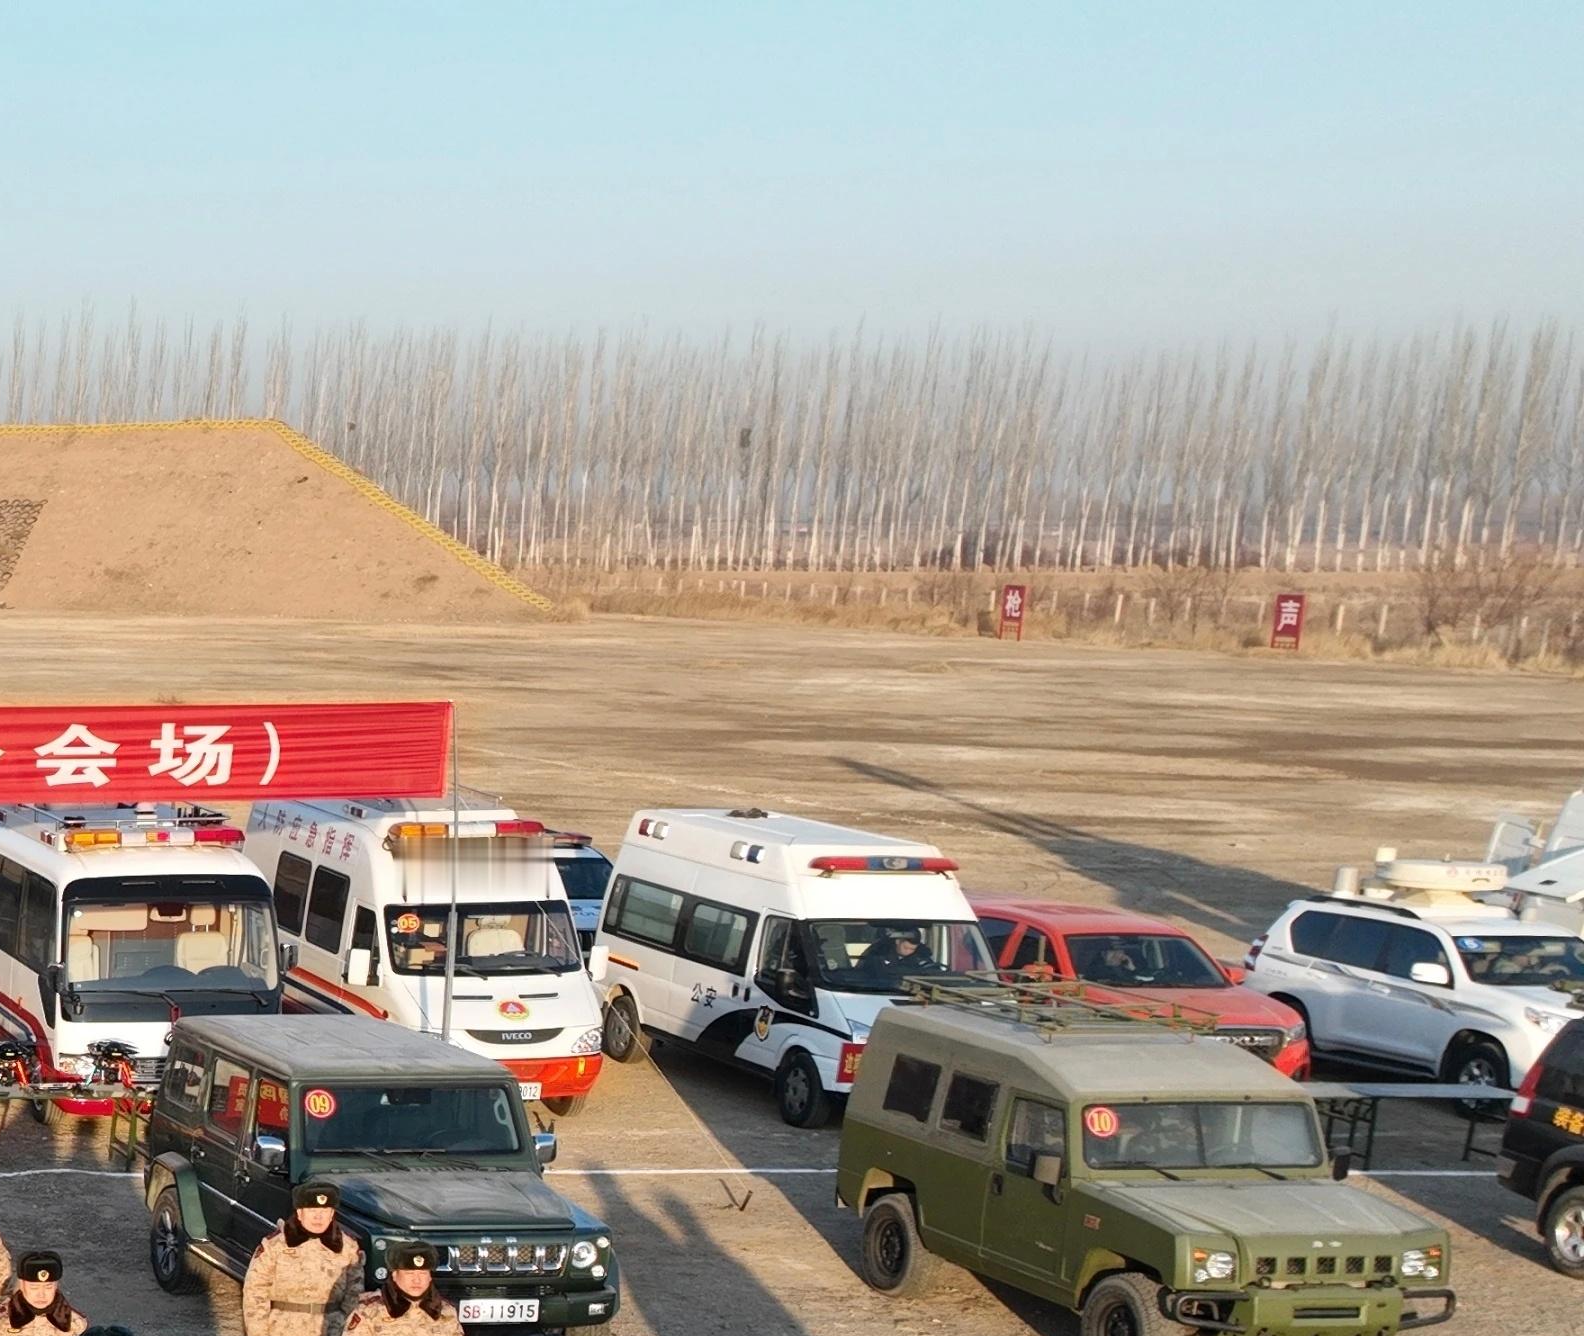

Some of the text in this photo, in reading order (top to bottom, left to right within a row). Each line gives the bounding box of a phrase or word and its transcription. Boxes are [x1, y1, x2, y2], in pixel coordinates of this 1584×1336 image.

[397, 914, 420, 933] 05
[690, 982, 717, 1009] 公安
[501, 1032, 533, 1040] IVECO
[308, 1093, 332, 1114] 09
[1090, 1111, 1112, 1133] 10
